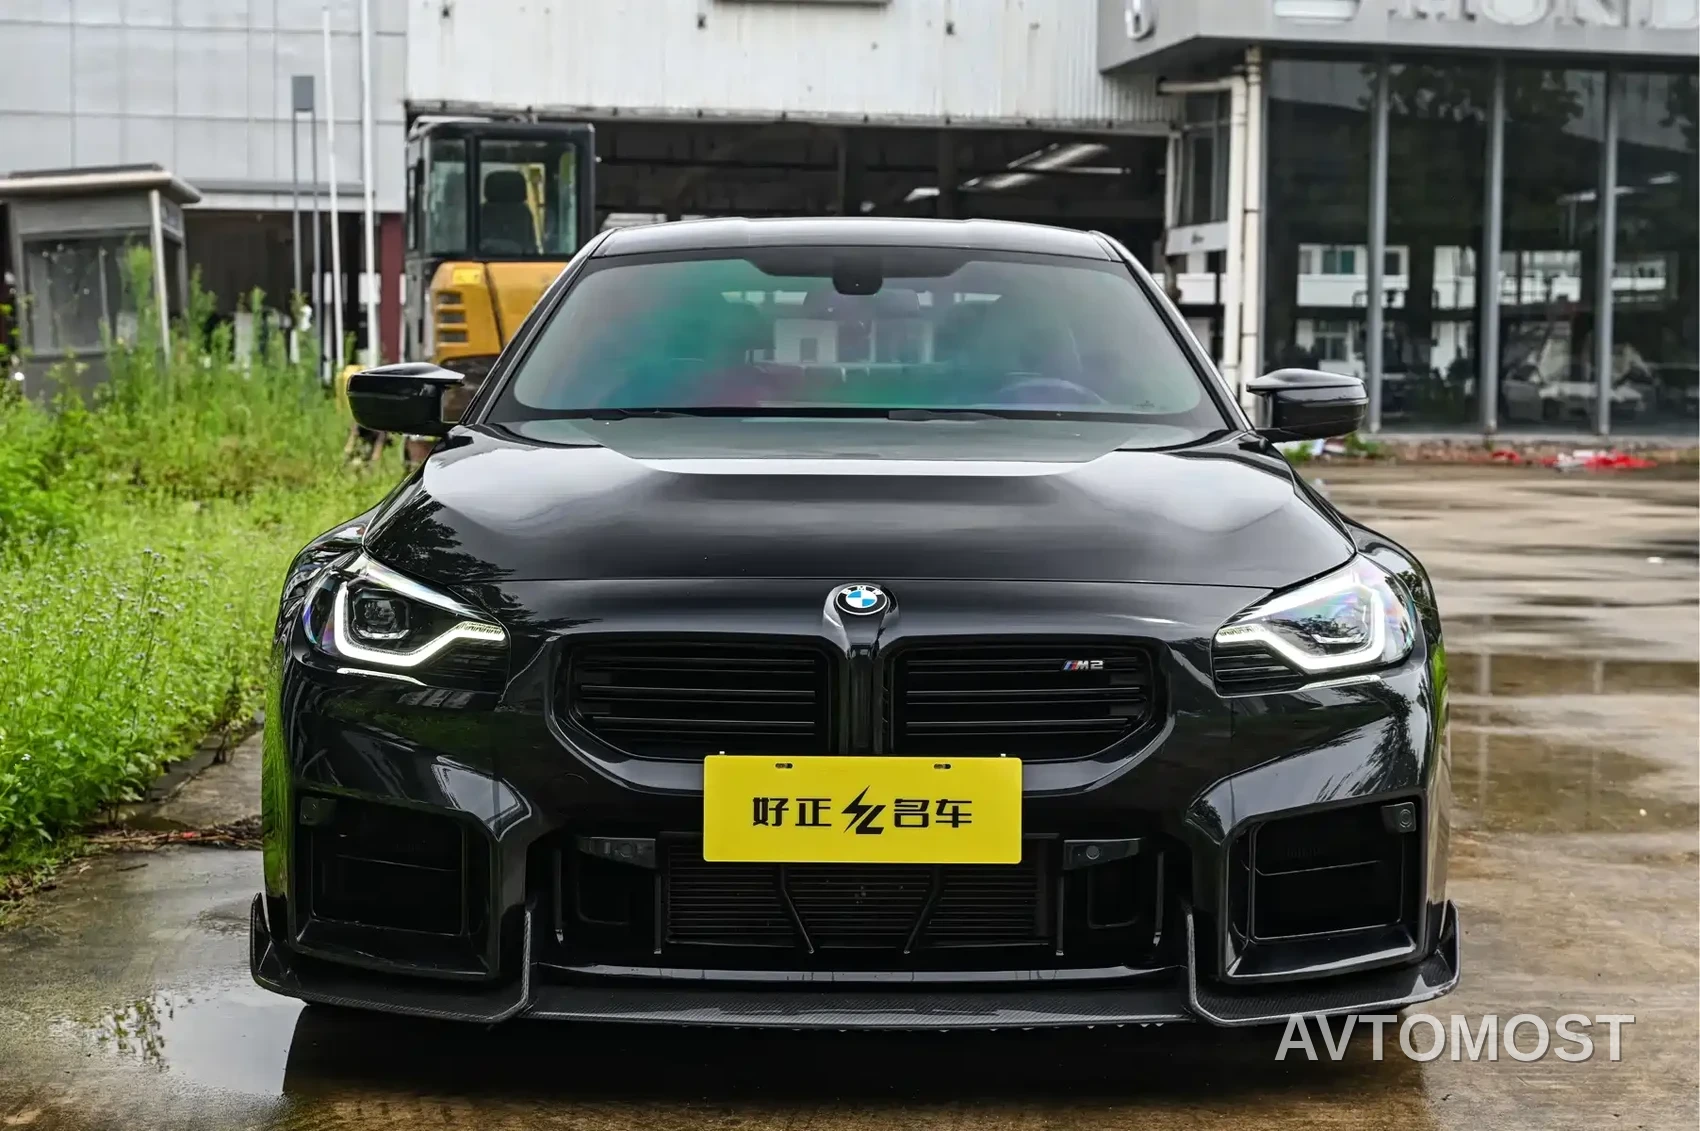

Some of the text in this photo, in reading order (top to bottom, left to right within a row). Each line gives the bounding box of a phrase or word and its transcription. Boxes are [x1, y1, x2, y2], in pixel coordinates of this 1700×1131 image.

[841, 585, 884, 596] BMW
[1075, 660, 1104, 671] M2
[753, 797, 832, 827] 好正
